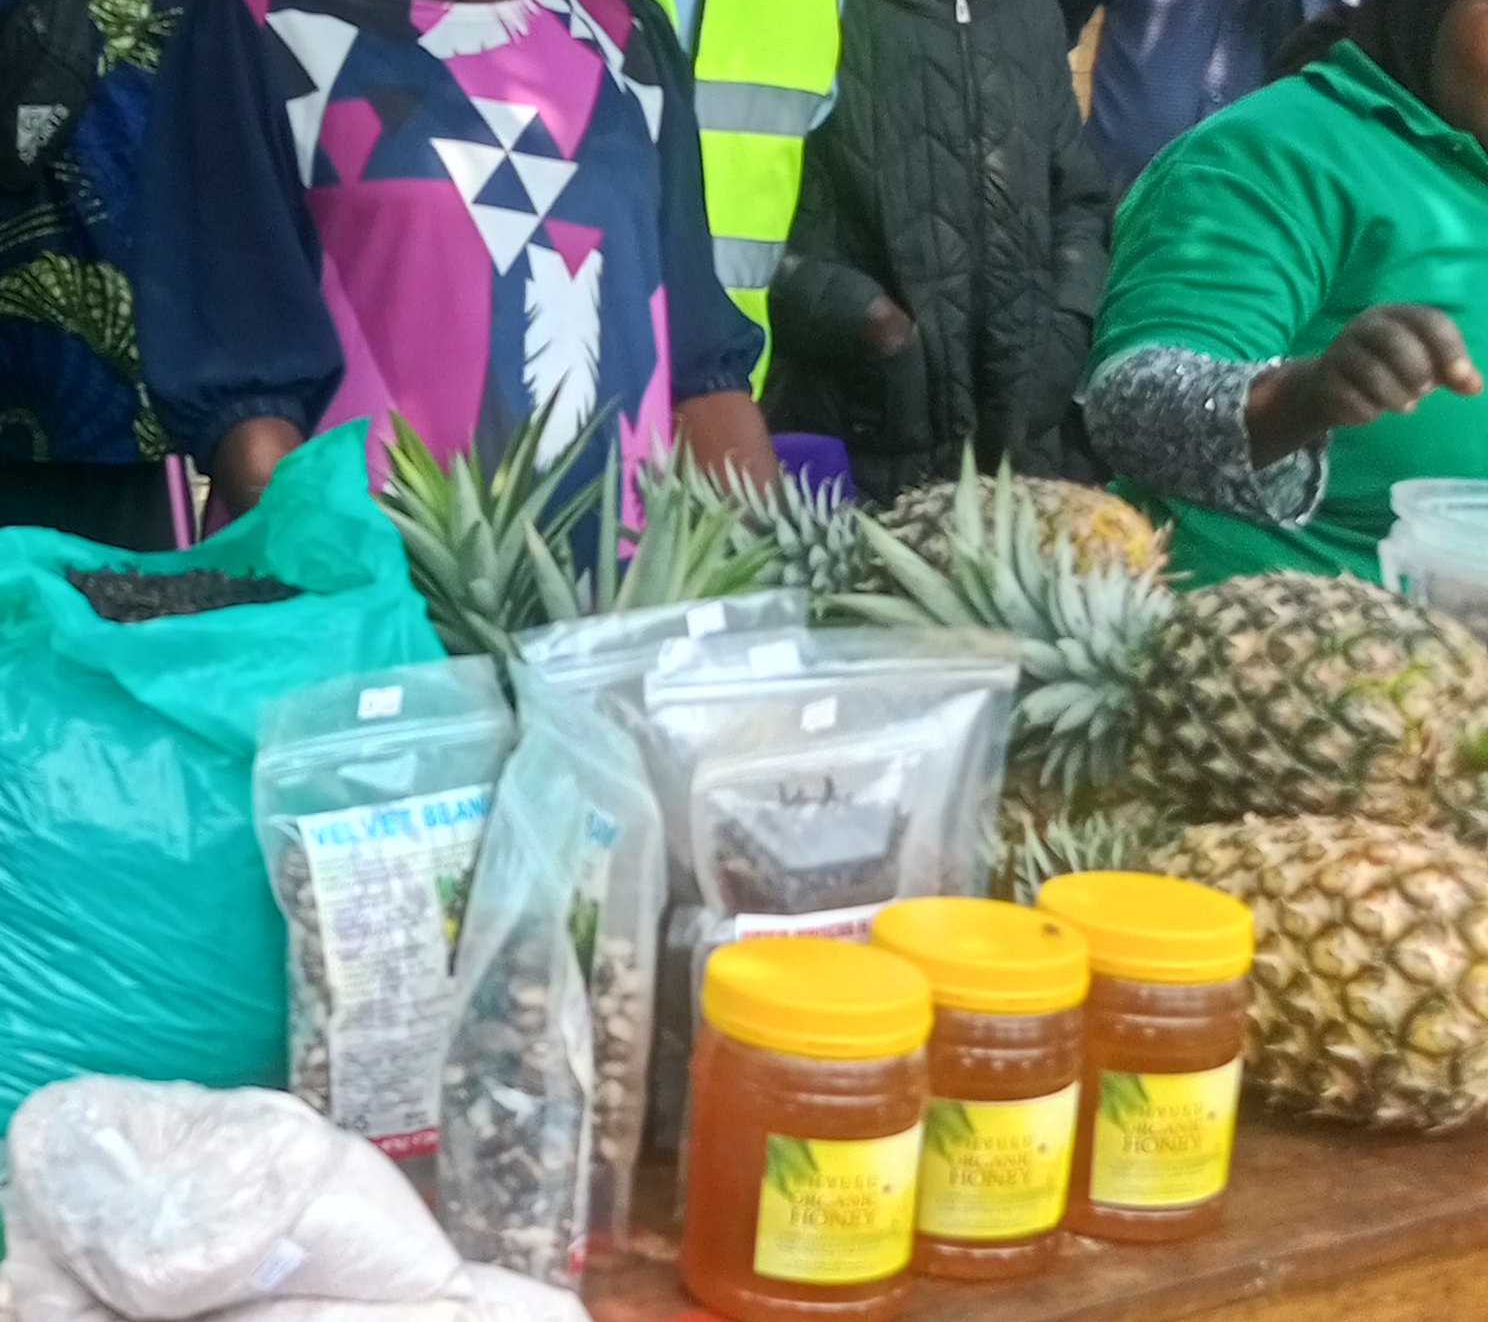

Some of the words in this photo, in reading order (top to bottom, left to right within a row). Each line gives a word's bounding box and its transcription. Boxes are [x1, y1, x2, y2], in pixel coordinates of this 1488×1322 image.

[313, 808, 411, 845] VELVET
[1122, 1134, 1203, 1153] HONEY
[948, 1167, 1031, 1187] HONEY
[789, 1207, 878, 1227] HONEY
